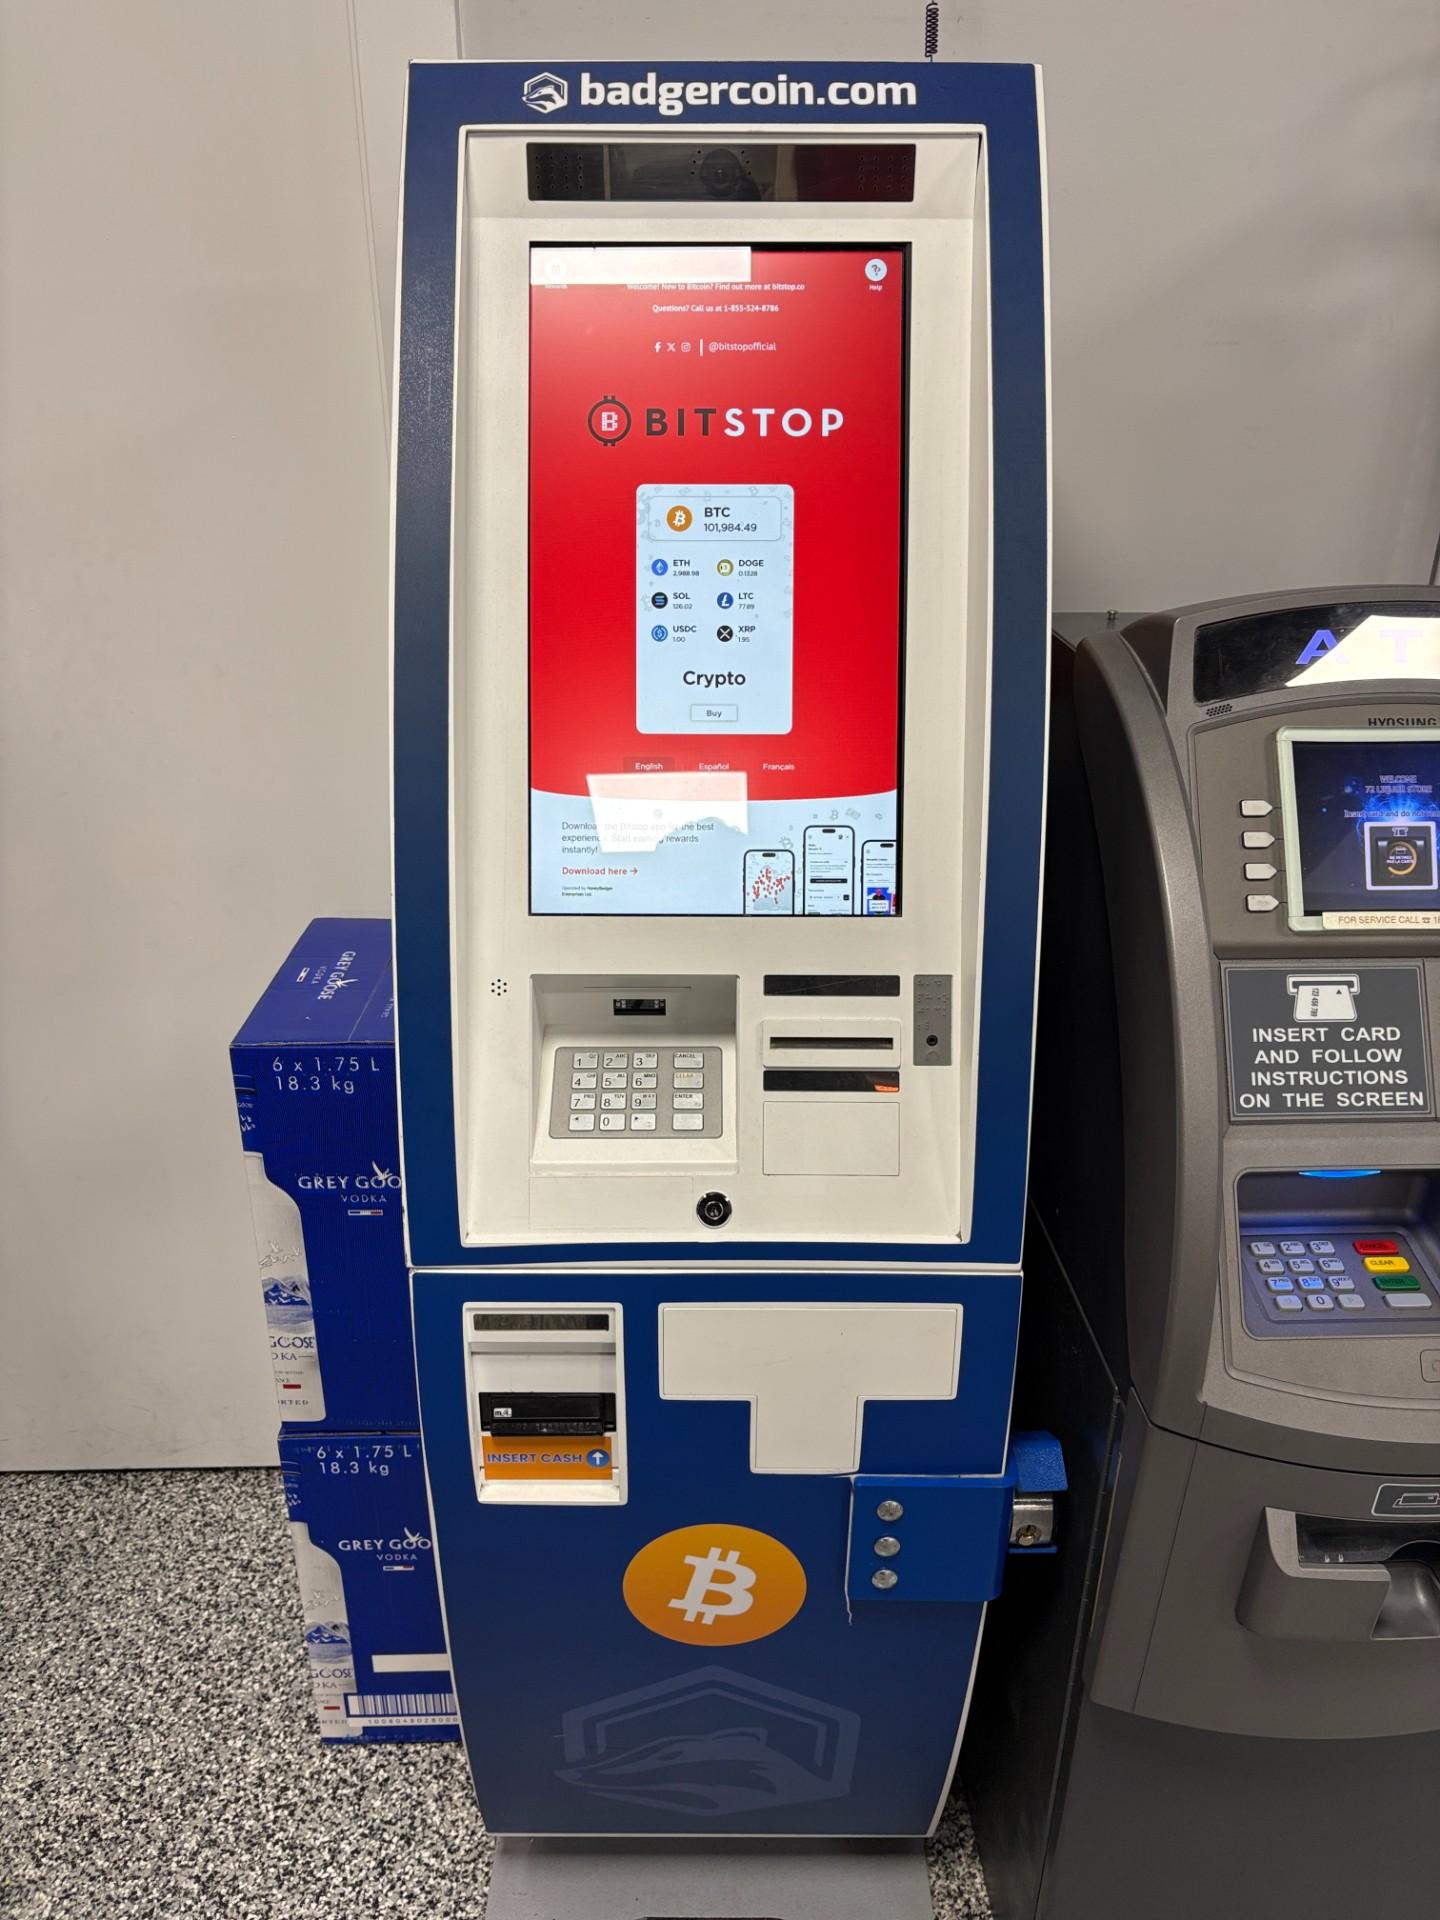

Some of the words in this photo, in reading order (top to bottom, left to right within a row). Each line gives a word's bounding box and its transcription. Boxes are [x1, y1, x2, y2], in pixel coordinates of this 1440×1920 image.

[581, 72, 916, 116] badgercoin.com
[772, 283, 805, 292] bitstop.co
[652, 304, 690, 313] Questions?
[690, 304, 704, 312] Call
[724, 304, 779, 312] 1-855-524-8786
[709, 342, 777, 352] @bitstopofficial
[646, 407, 844, 437] BITSTOP
[704, 507, 730, 518] BTC
[704, 523, 757, 533] 101,984.49
[673, 559, 690, 567] ETH
[738, 559, 764, 567] DOGE
[673, 592, 690, 600] SOL
[738, 592, 754, 600] LTC
[673, 625, 697, 633] USDC
[738, 625, 756, 633] XRP
[683, 670, 746, 689] Crypto
[706, 709, 723, 719] Buy
[635, 762, 663, 771] English
[699, 762, 729, 771] Español
[762, 763, 795, 771] Français
[1380, 774, 1417, 784] WELCOME
[1407, 785, 1433, 793] STORE
[562, 822, 598, 831] Downloa
[696, 823, 714, 831] best
[666, 835, 699, 843] rewards
[562, 846, 598, 855] instantly!
[562, 867, 605, 875] Download
[608, 867, 627, 875] here
[1339, 916, 1357, 924] FOR
[1358, 916, 1397, 924] SERVICE
[1398, 915, 1420, 924] CALL
[335, 951, 357, 971] GREY
[317, 971, 345, 1000] GOOSE
[1252, 1027, 1328, 1042] INSERT
[1340, 1026, 1401, 1042] CARD
[1254, 1049, 1300, 1065] AND
[1312, 1048, 1402, 1064] FOLLOW
[272, 1056, 283, 1072] 6
[294, 1061, 303, 1072] x
[315, 1056, 359, 1072] 1.75
[371, 1056, 380, 1072] L
[576, 1058, 582, 1067] 1
[605, 1058, 613, 1067] 2
[636, 1058, 643, 1066] 3
[574, 1078, 581, 1087] 4
[604, 1078, 612, 1086] 5
[635, 1077, 643, 1086] 6
[1251, 1070, 1408, 1086] INSTRUCTIONS
[276, 1076, 321, 1091] 18.3
[332, 1075, 355, 1094] kg
[573, 1098, 581, 1107] 7
[603, 1098, 611, 1107] 8
[634, 1098, 642, 1107] 9
[1239, 1093, 1270, 1108] ON
[1282, 1092, 1325, 1107] THE
[1337, 1091, 1424, 1107] SCREEN
[602, 1117, 610, 1127] 0
[298, 1176, 349, 1189] GREY
[341, 1194, 387, 1203] VODKA
[1254, 1244, 1261, 1252] 1
[1283, 1243, 1291, 1251] 2
[1313, 1242, 1321, 1251] 3
[1263, 1261, 1271, 1269] 4
[1292, 1261, 1300, 1269] 5
[1322, 1260, 1330, 1268] 6
[1271, 1279, 1278, 1287] 7
[1302, 1278, 1311, 1287] 8
[1332, 1278, 1340, 1287] 9
[1316, 1296, 1325, 1305] 0
[269, 1335, 315, 1349] GOOSE
[317, 1446, 326, 1459] 6
[336, 1450, 344, 1459] x
[354, 1445, 394, 1458] 1.75
[403, 1445, 412, 1457] L
[487, 1453, 537, 1463] INSERT
[540, 1453, 582, 1463] CASH
[320, 1461, 359, 1474] 18.3
[369, 1461, 389, 1476] kg
[338, 1539, 384, 1551] GREY
